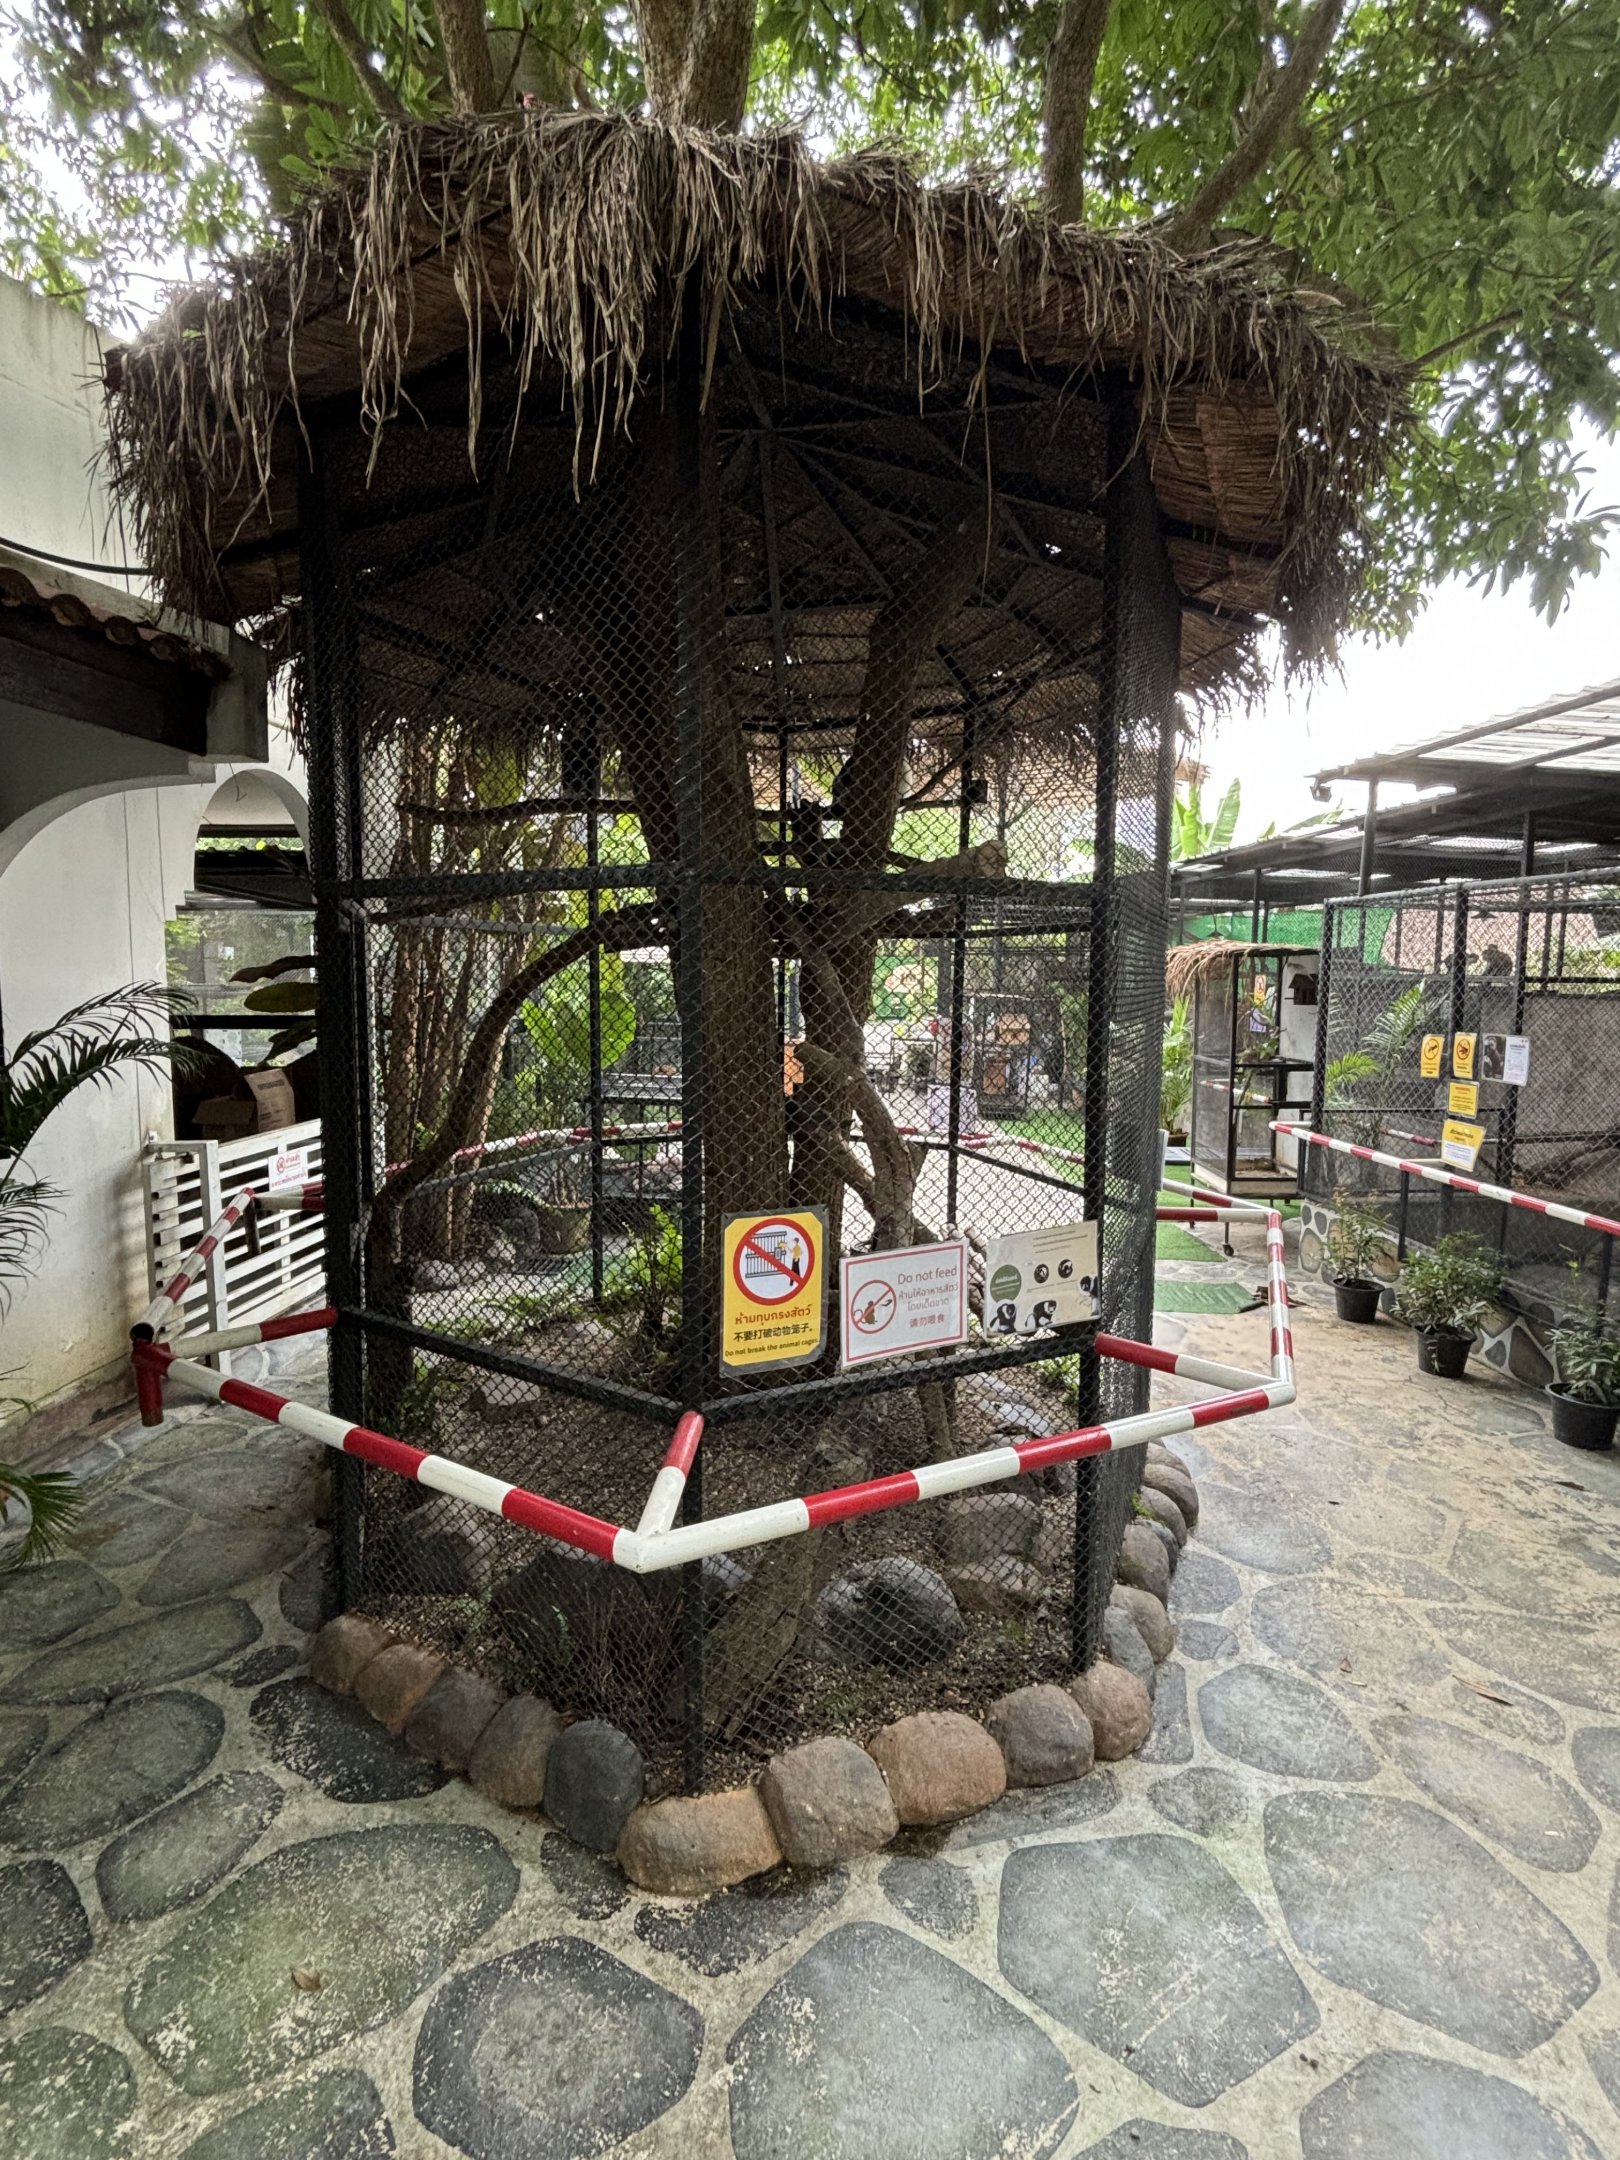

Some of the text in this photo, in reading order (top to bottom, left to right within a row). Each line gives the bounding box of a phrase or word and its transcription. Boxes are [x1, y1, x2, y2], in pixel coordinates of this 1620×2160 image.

[897, 1264, 957, 1285] Do not feed
[735, 1304, 812, 1326] ห้ามทุบกรงสัตว์
[734, 1347, 747, 1356] not
[747, 1345, 766, 1354] break
[779, 1340, 801, 1349] animal
